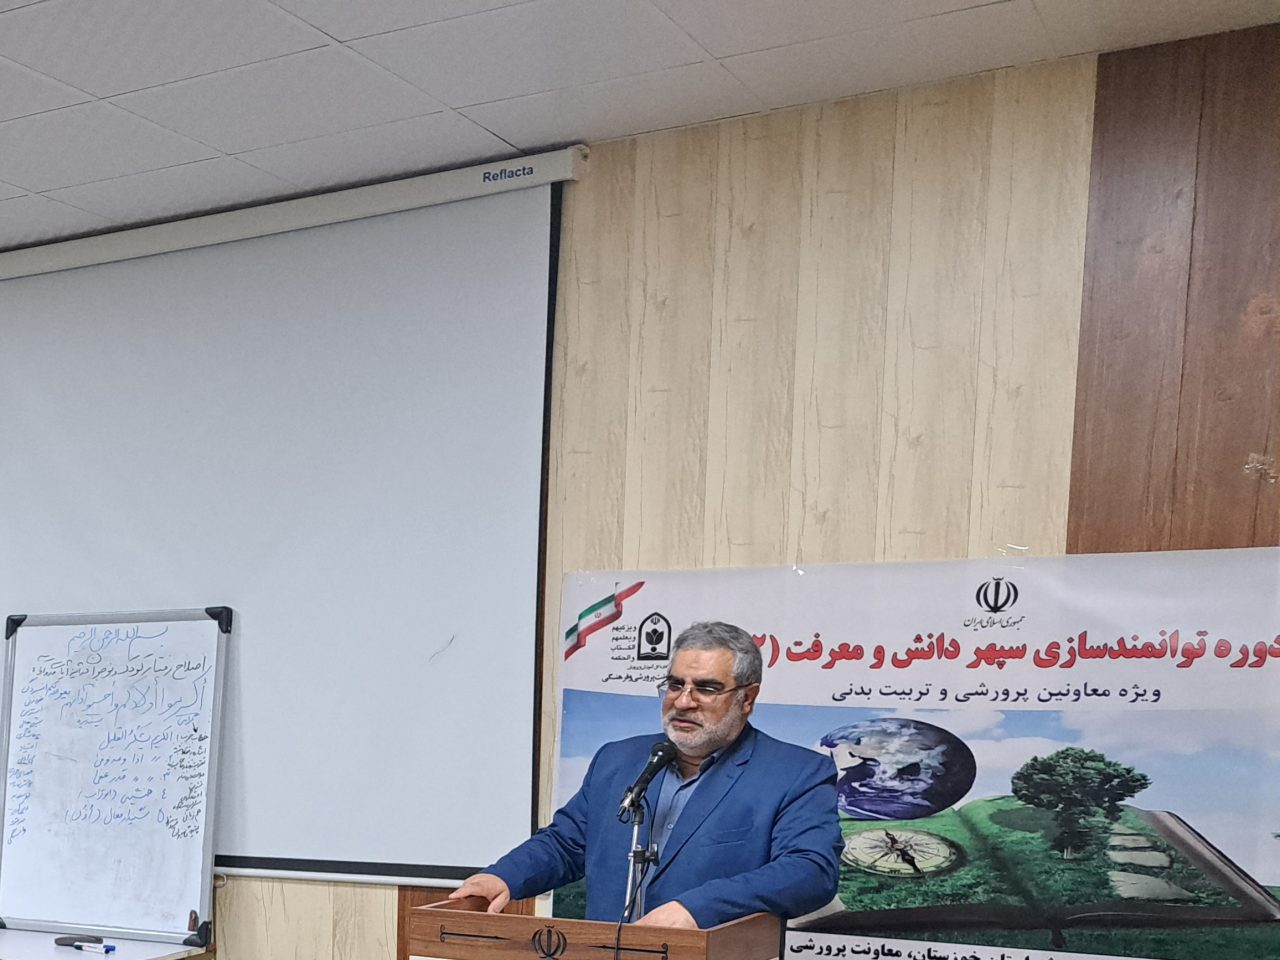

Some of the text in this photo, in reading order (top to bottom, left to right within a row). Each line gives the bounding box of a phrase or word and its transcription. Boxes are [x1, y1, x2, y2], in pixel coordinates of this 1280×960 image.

[482, 165, 534, 183] Reflacta
[786, 633, 865, 670] معرفت
[869, 644, 886, 669] و
[891, 632, 961, 669] دانش
[965, 641, 1028, 670] سپهر
[832, 682, 1162, 703] ویژه معاونین پرورشی و تربیت بدنی
[789, 937, 847, 958] پرورشی
[850, 943, 903, 960] معاونت
